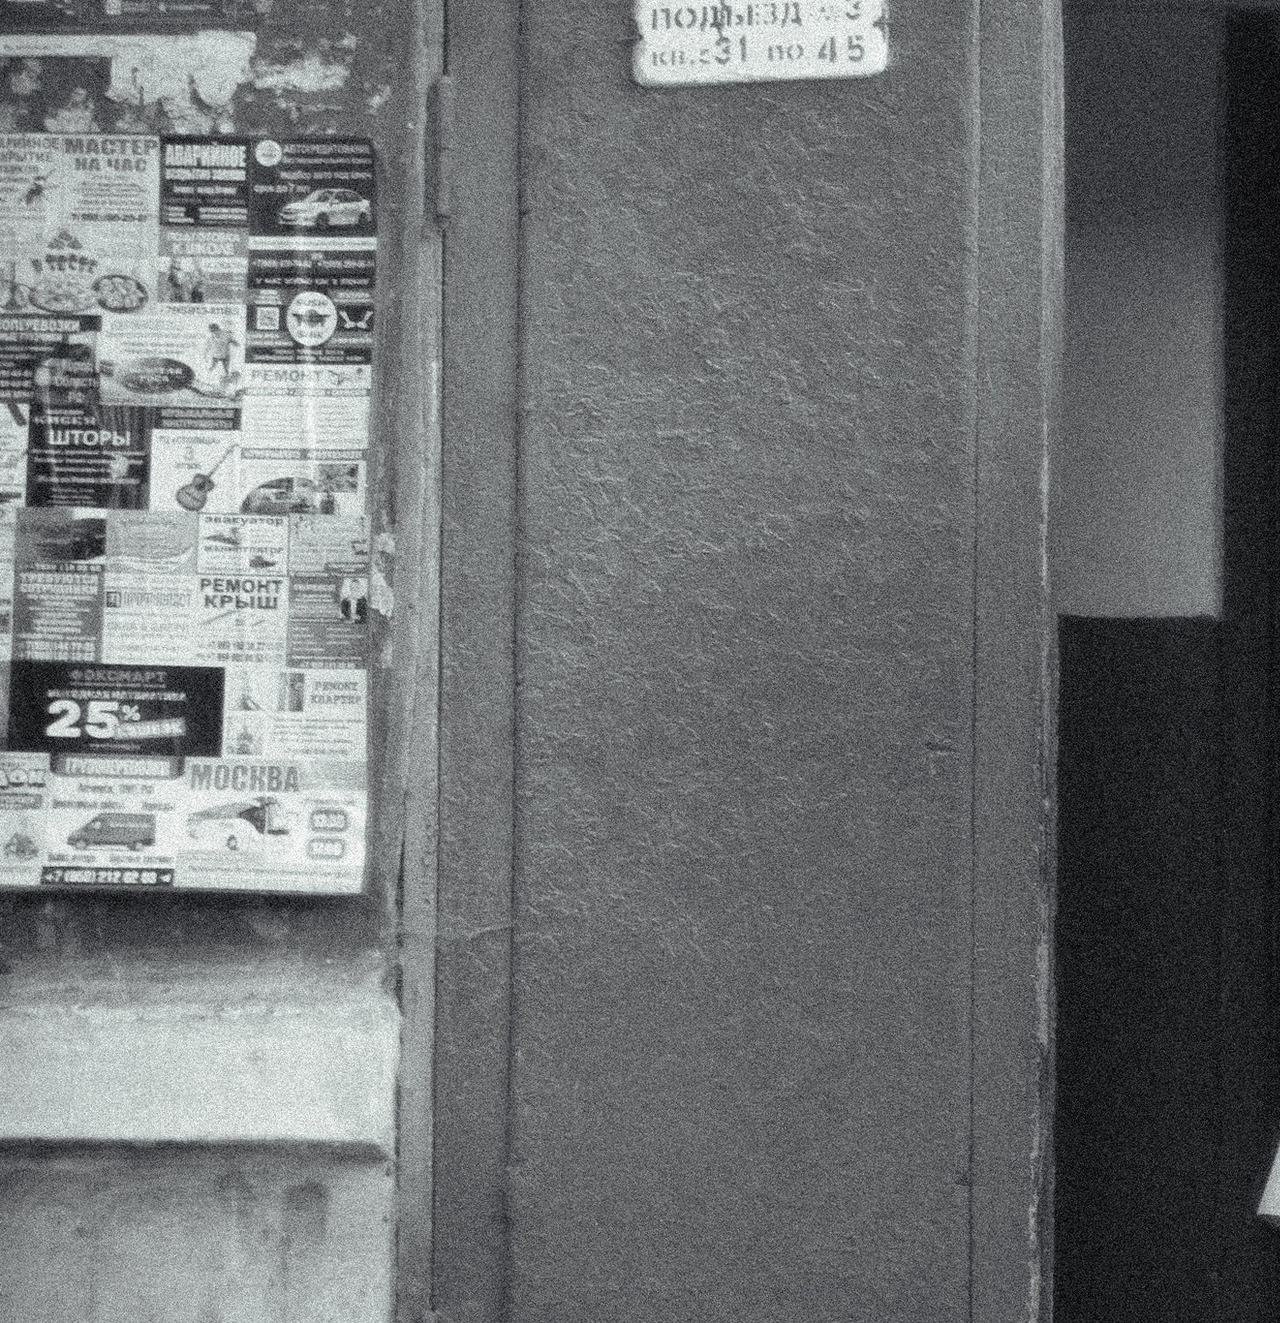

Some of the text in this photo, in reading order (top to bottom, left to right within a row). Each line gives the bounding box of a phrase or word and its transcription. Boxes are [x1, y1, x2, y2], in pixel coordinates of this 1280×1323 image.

[768, 44, 804, 61] по
[818, 35, 865, 64] 45
[64, 138, 159, 155] МАСТЕР
[74, 157, 148, 173] НА ЧАС
[48, 429, 131, 446] ШТОРЫ
[200, 578, 283, 594] РЕМОНТ
[204, 595, 278, 610] КРЫШ
[190, 764, 300, 791] МОСКВА
